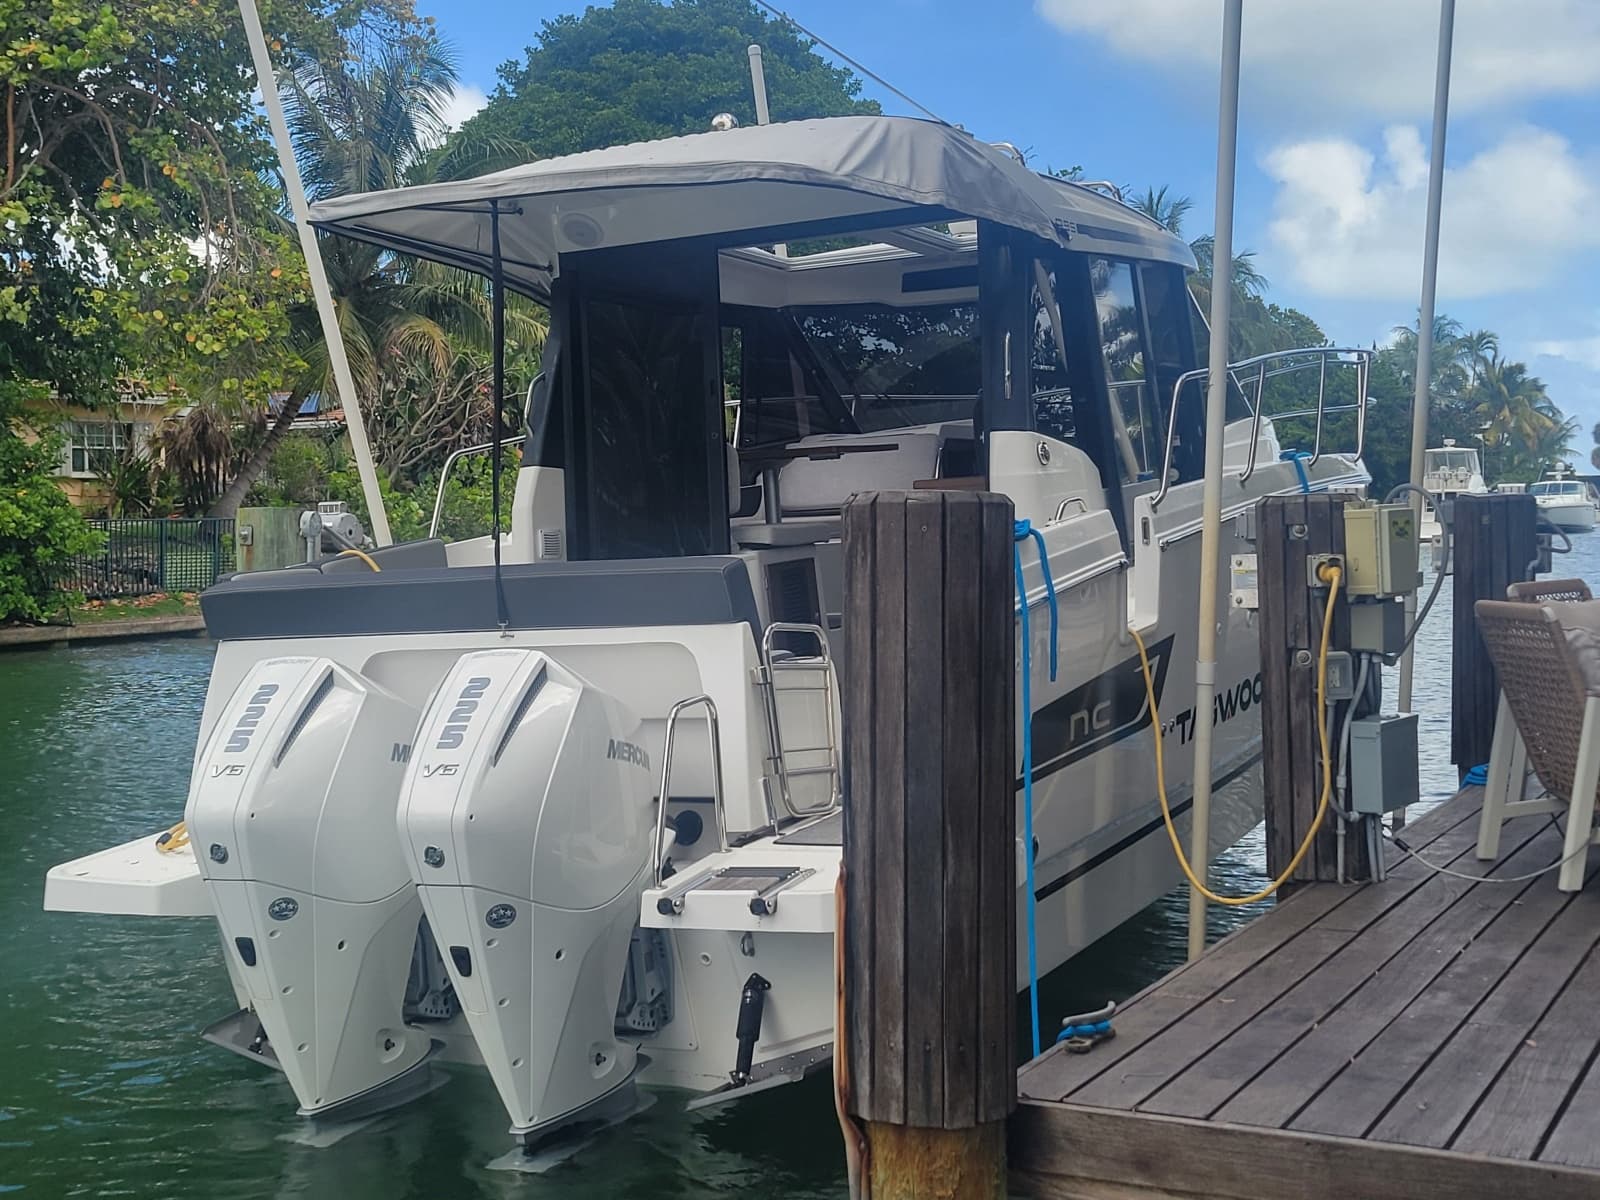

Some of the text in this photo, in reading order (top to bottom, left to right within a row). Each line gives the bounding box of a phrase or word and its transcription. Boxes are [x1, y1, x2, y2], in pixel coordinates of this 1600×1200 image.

[224, 684, 279, 752] 225
[436, 677, 491, 749] 225
[211, 764, 245, 777] V6
[423, 763, 459, 777] V6
